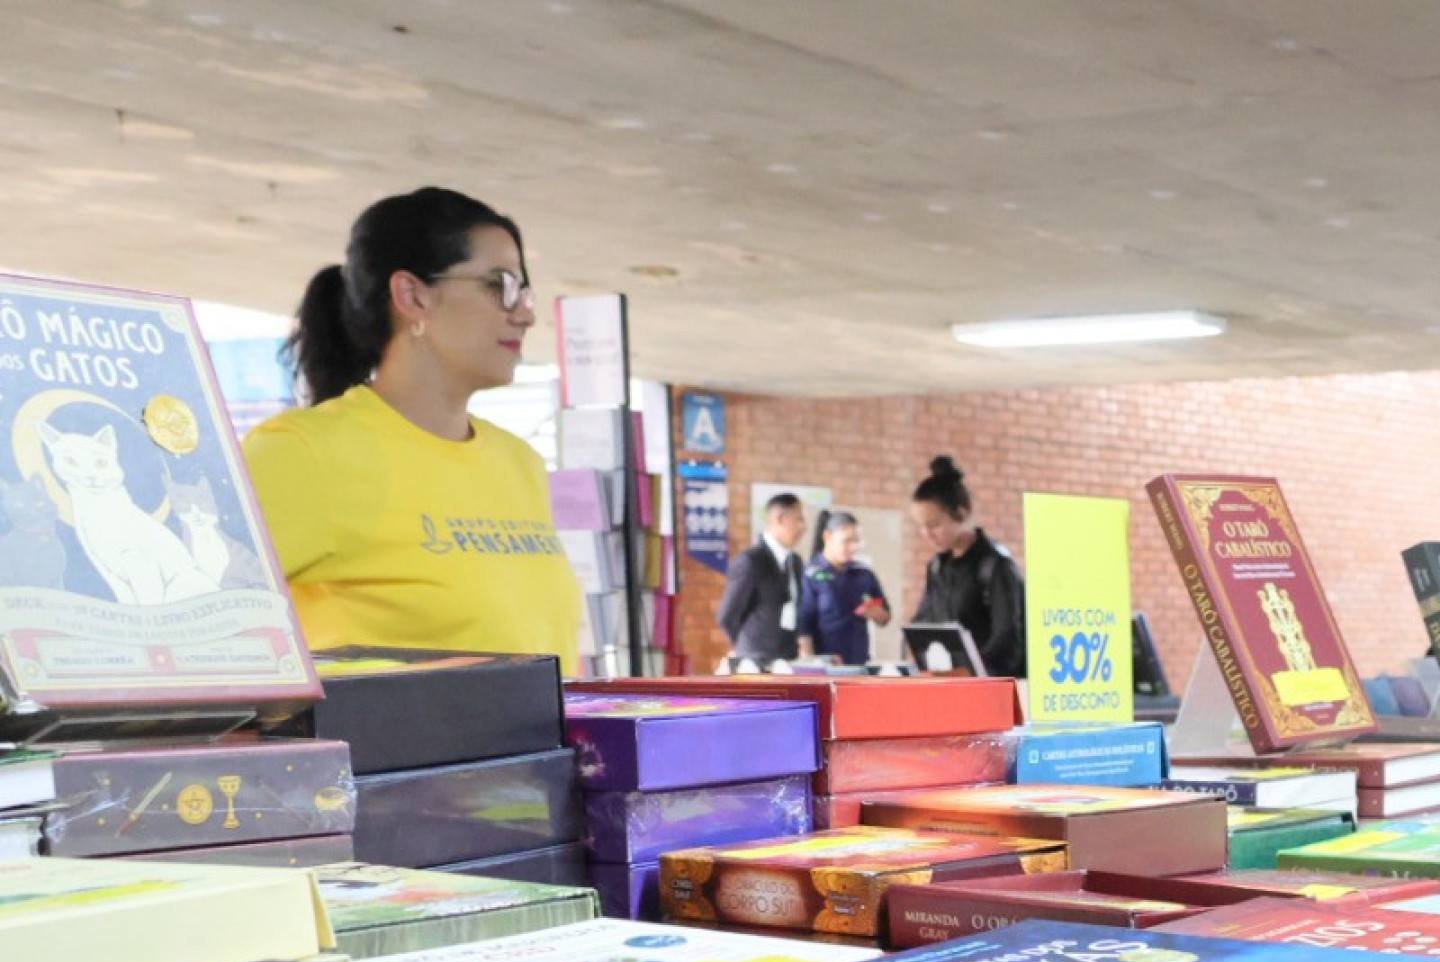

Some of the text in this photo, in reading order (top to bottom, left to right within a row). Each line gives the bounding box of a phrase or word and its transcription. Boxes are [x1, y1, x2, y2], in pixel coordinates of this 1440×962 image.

[36, 306, 165, 354] MÁGICO
[30, 348, 139, 389] GATOS
[1042, 609, 1116, 626] LIVROS COM
[1184, 563, 1260, 729] O TARÔ CABALÍSTICO
[1050, 631, 1111, 683] 30%
[1044, 691, 1120, 712] DE DESCONTO
[904, 910, 960, 928] MIRANDA
[971, 914, 984, 930] O
[919, 926, 950, 940] GRAY
